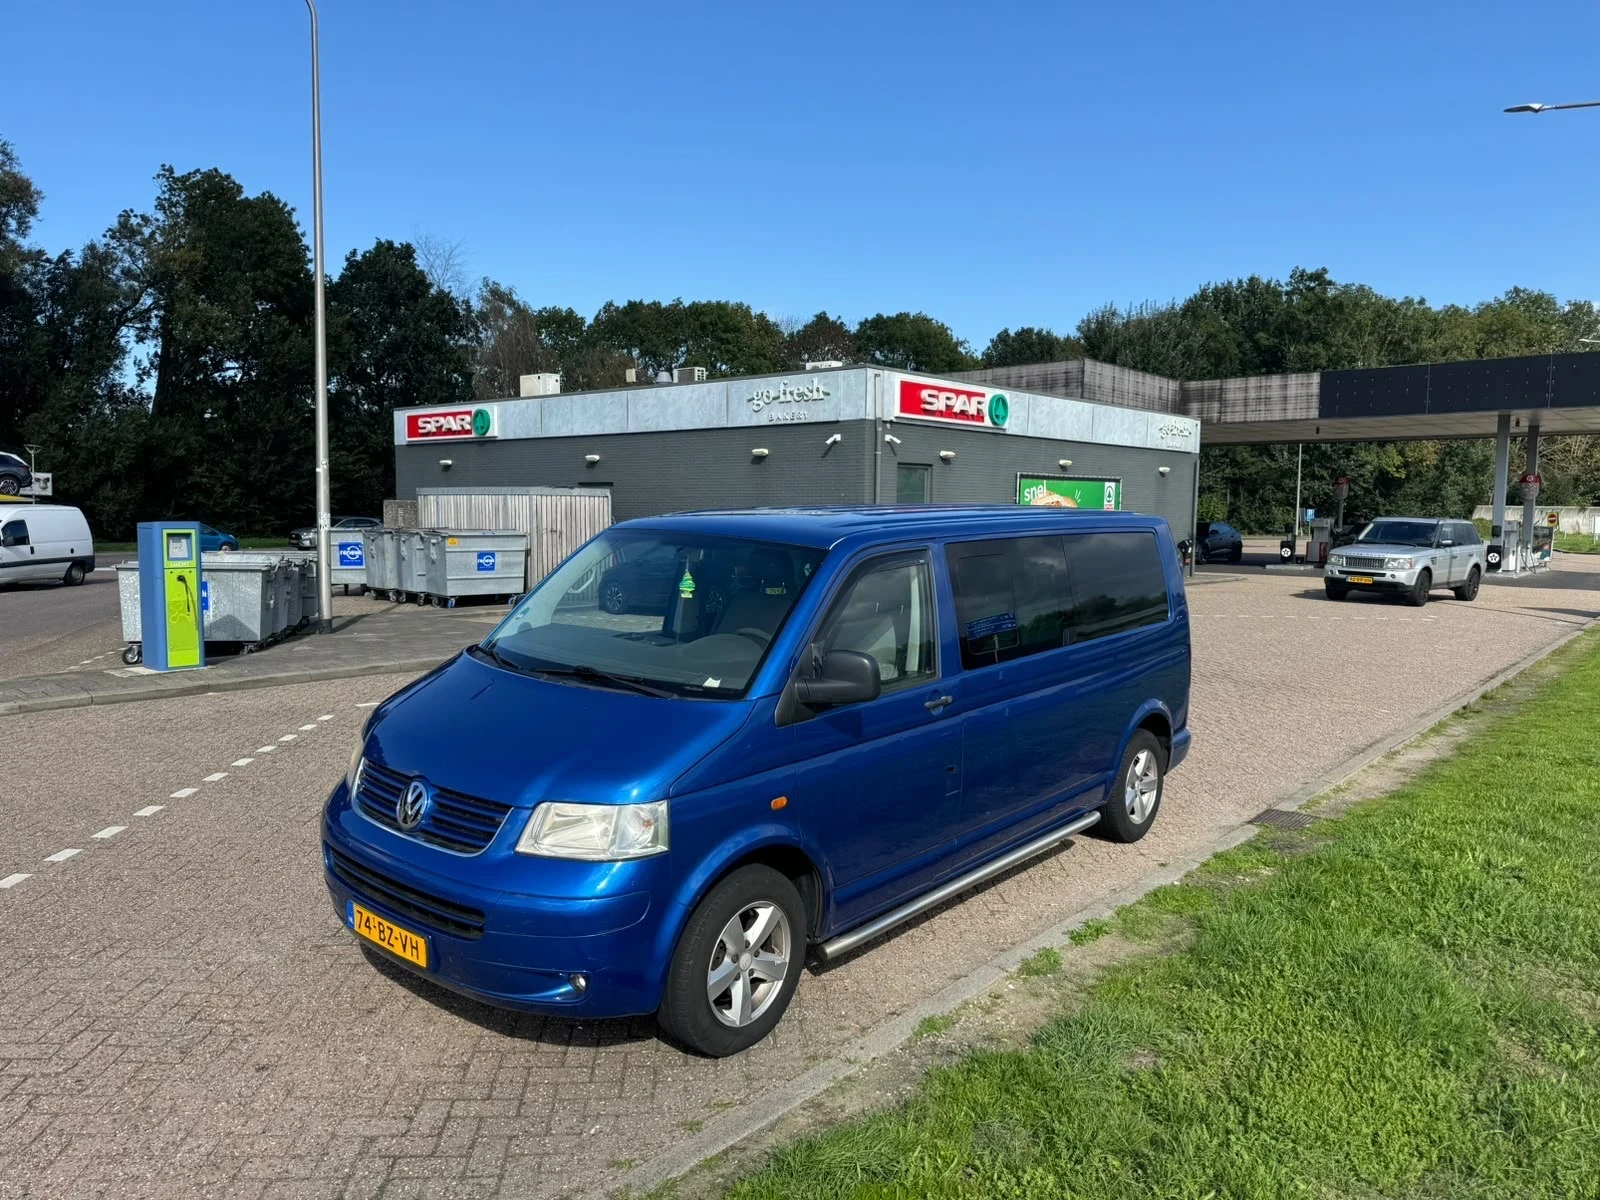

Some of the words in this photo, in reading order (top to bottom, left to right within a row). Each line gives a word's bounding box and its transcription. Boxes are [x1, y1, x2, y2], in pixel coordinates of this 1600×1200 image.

[752, 389, 774, 413] go
[779, 377, 825, 404] fresh
[920, 388, 986, 418] SPAR
[417, 414, 472, 434] SPAR
[768, 410, 808, 422] BAKERY
[1024, 480, 1047, 502] snel
[356, 909, 420, 961] 74-BZ-VH
